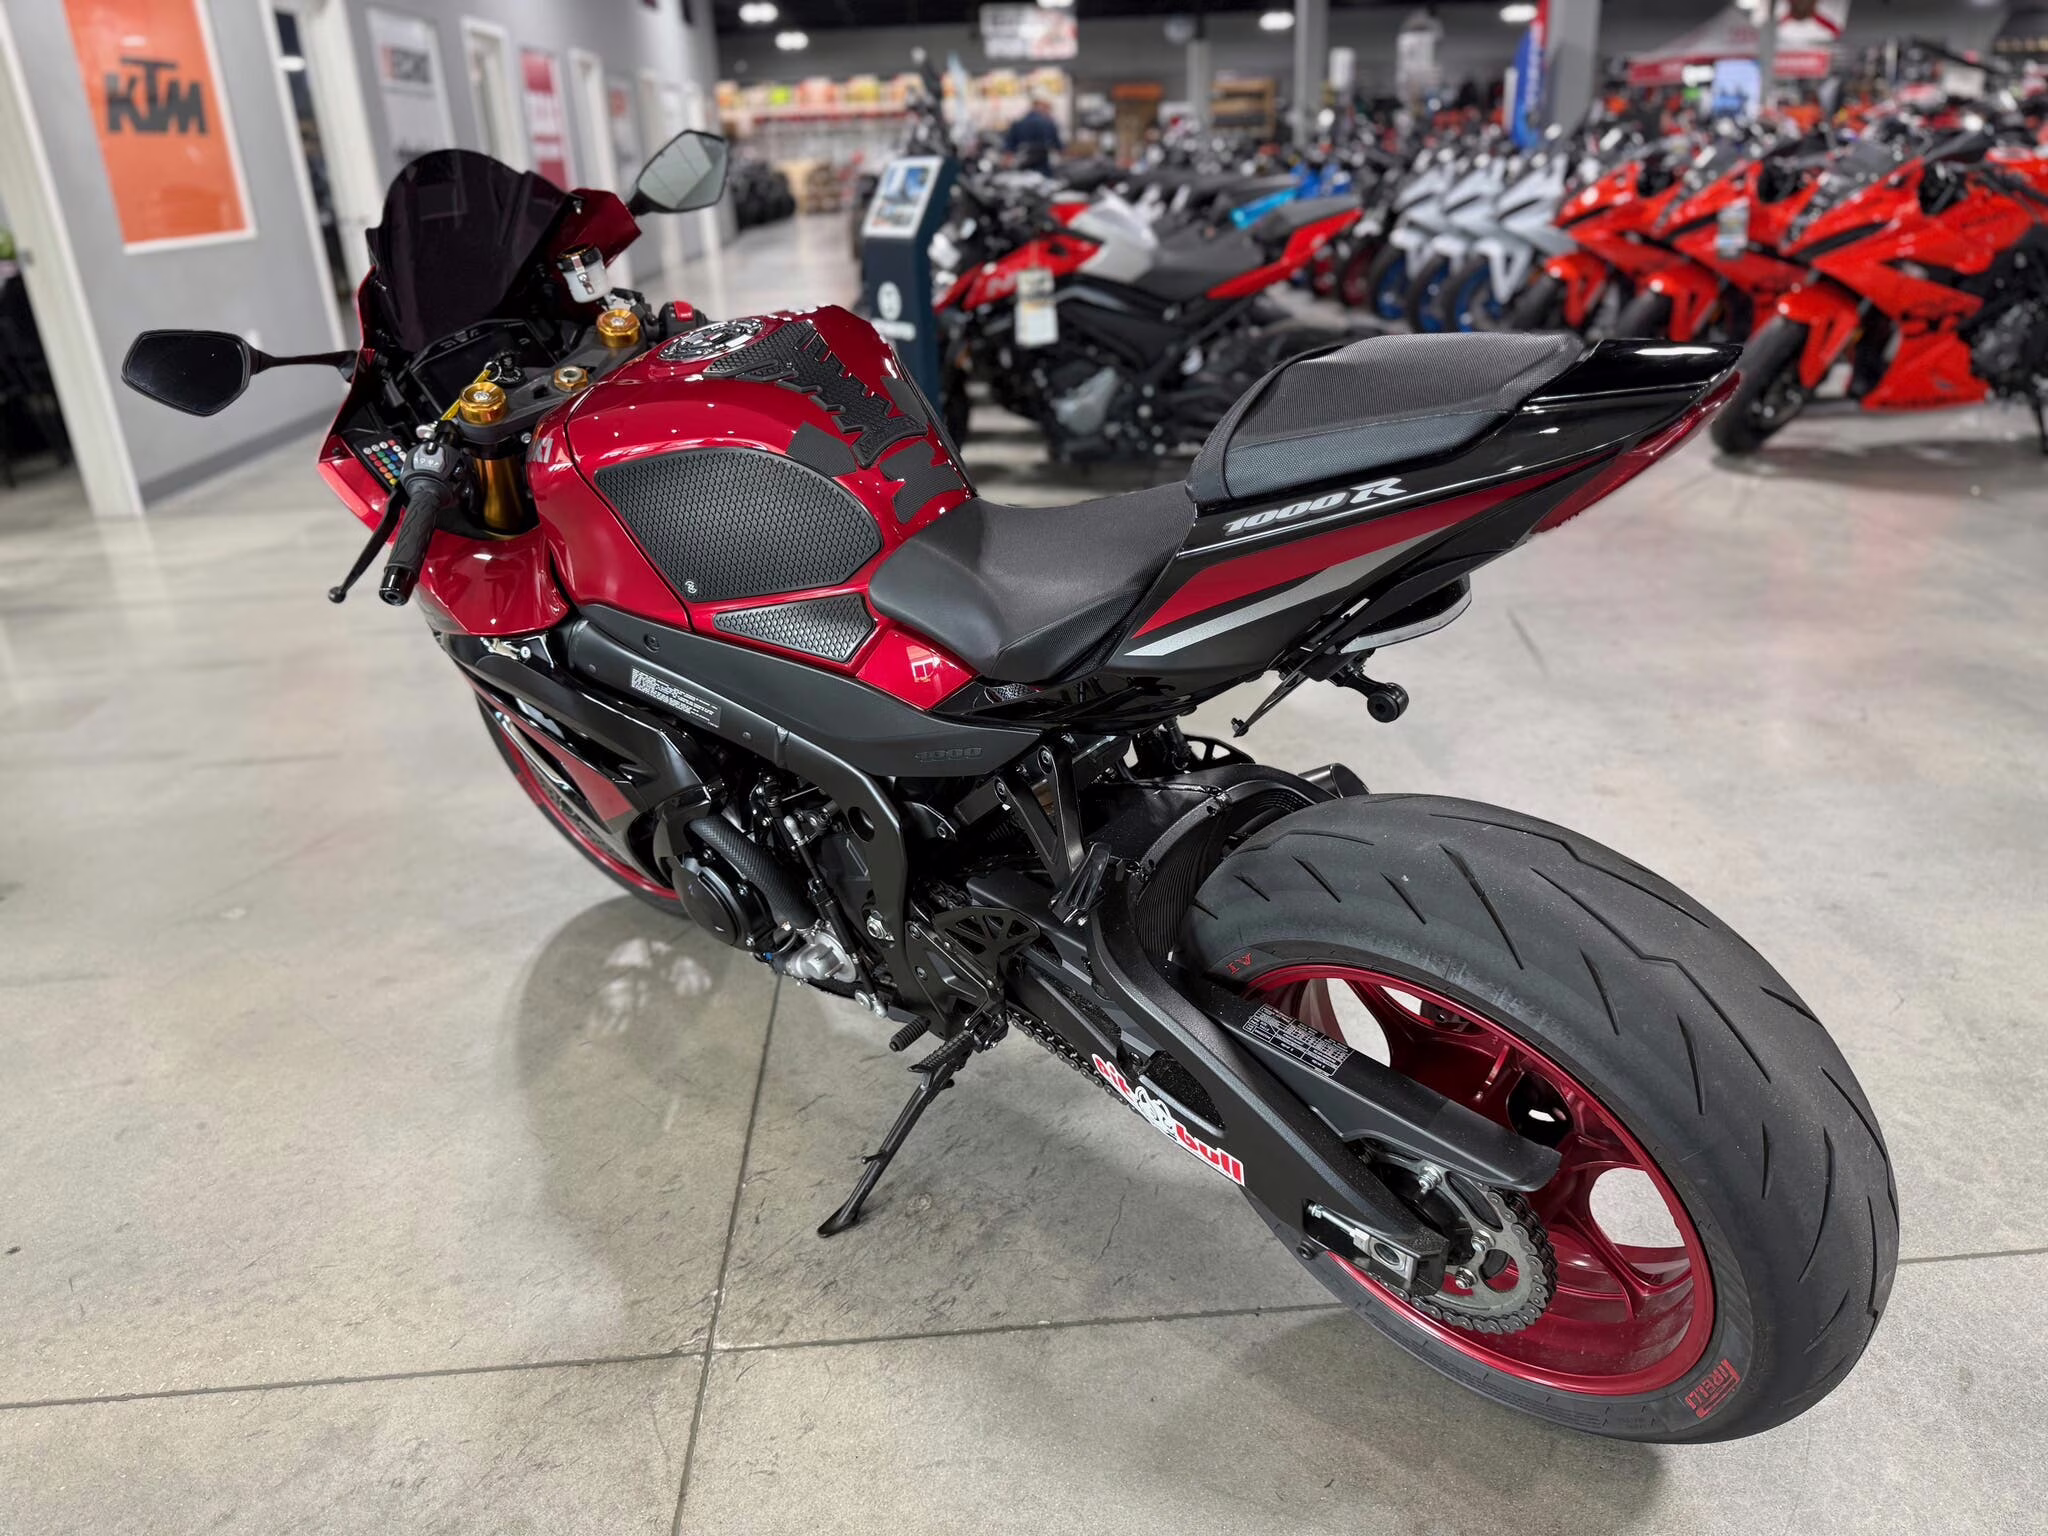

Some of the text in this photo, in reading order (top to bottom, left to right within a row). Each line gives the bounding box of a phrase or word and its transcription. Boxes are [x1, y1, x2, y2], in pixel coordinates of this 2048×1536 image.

[105, 56, 207, 135] KTM
[1174, 1122, 1243, 1185] bull
[1684, 1358, 1741, 1418] PIRELLI
